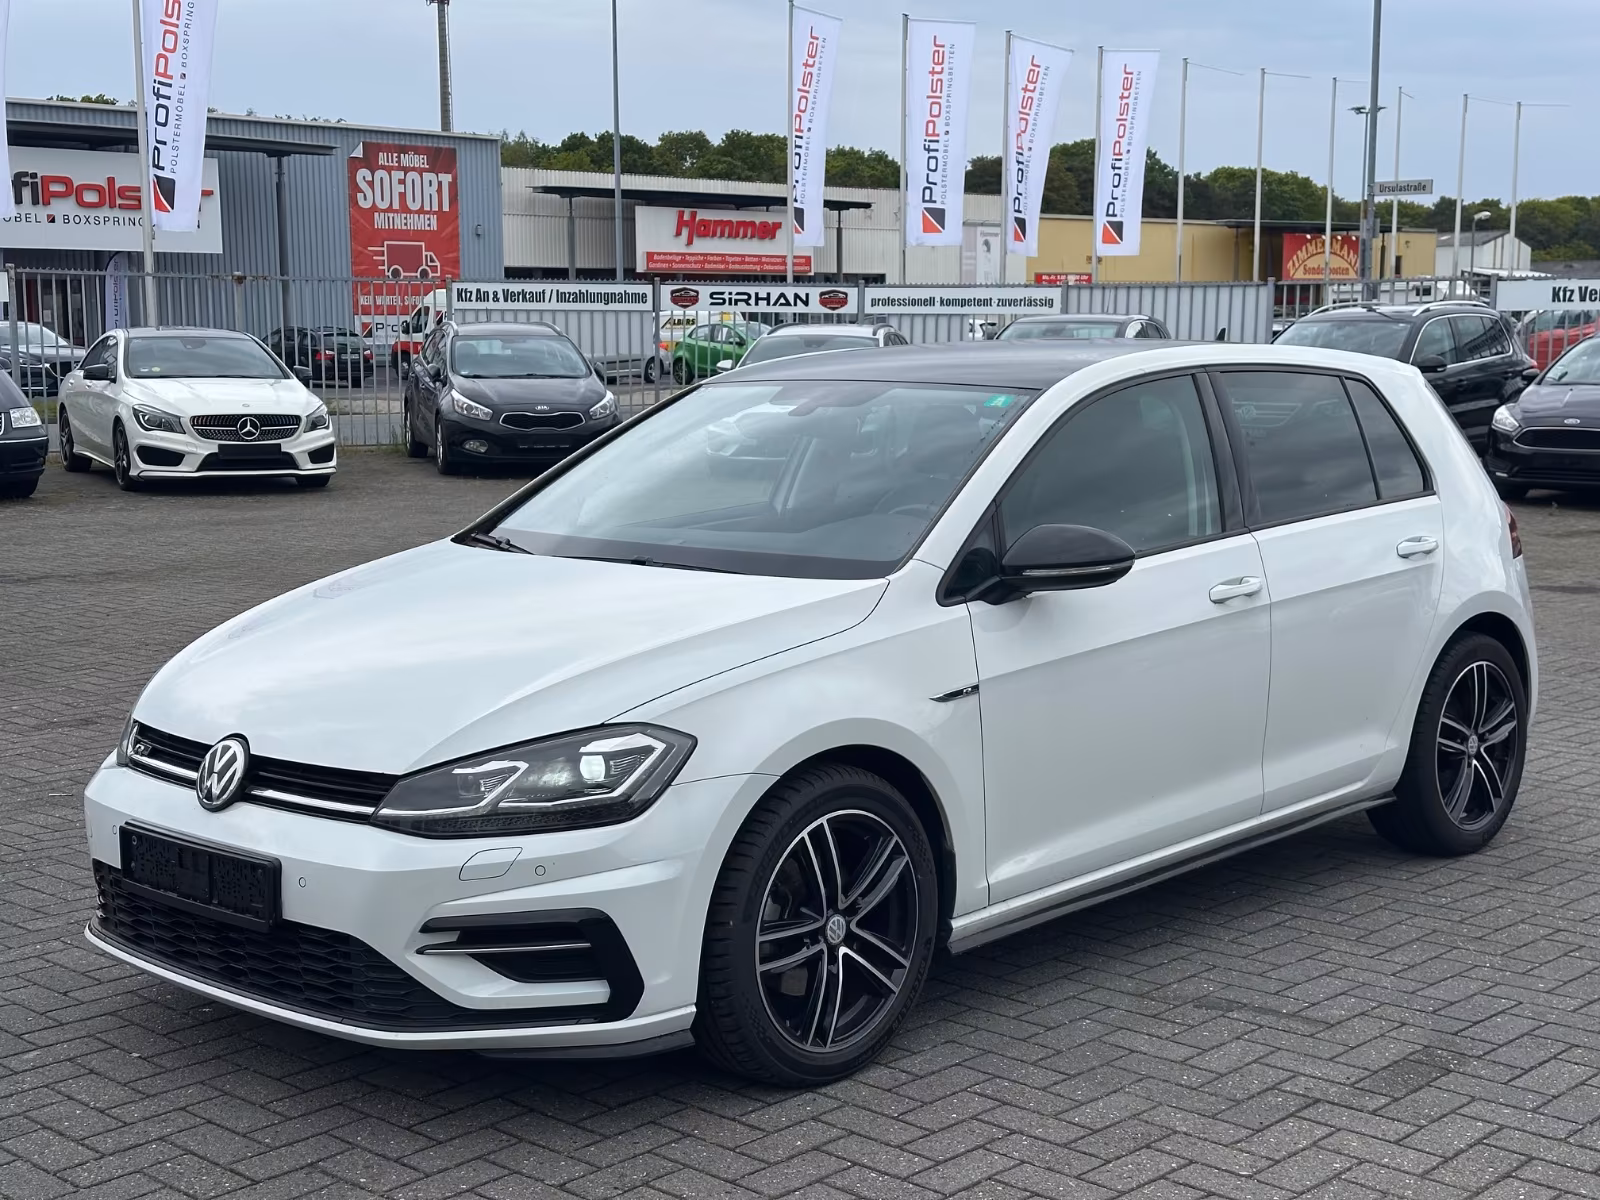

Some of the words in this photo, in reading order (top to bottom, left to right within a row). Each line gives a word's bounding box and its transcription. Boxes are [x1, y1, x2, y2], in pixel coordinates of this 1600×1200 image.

[181, 0, 195, 68] BOXSPRING
[944, 43, 956, 127] BOXSPRINGBETTEN
[922, 35, 946, 204] ProfiPolster
[1028, 66, 1050, 144] BOXSPRINGBETTEN
[1127, 71, 1142, 147] BOXSPRINGBETTEN
[1013, 55, 1042, 213] ProfiPolster
[1105, 63, 1135, 218] ProfiPolster
[378, 152, 399, 167] ALLE
[400, 151, 430, 168] MÖBEL
[12, 171, 214, 210] fiPols
[356, 168, 453, 212] SOFORT
[1379, 182, 1427, 193] Ursulastraße
[374, 212, 438, 231] MITNEHMEN
[674, 210, 783, 246] Hammer
[1303, 264, 1350, 276] Sondeosten
[456, 287, 473, 303] Kfz
[475, 288, 490, 303] An
[492, 290, 500, 303] &
[501, 288, 546, 304] Verkauf
[548, 289, 554, 303] /
[556, 289, 648, 306] Inzahlungnahme
[870, 296, 936, 308] professionell
[939, 296, 993, 309] kompetent
[996, 296, 1054, 309] zuverlässig
[1551, 286, 1575, 303] Kfz
[1578, 286, 1600, 302] Ve
